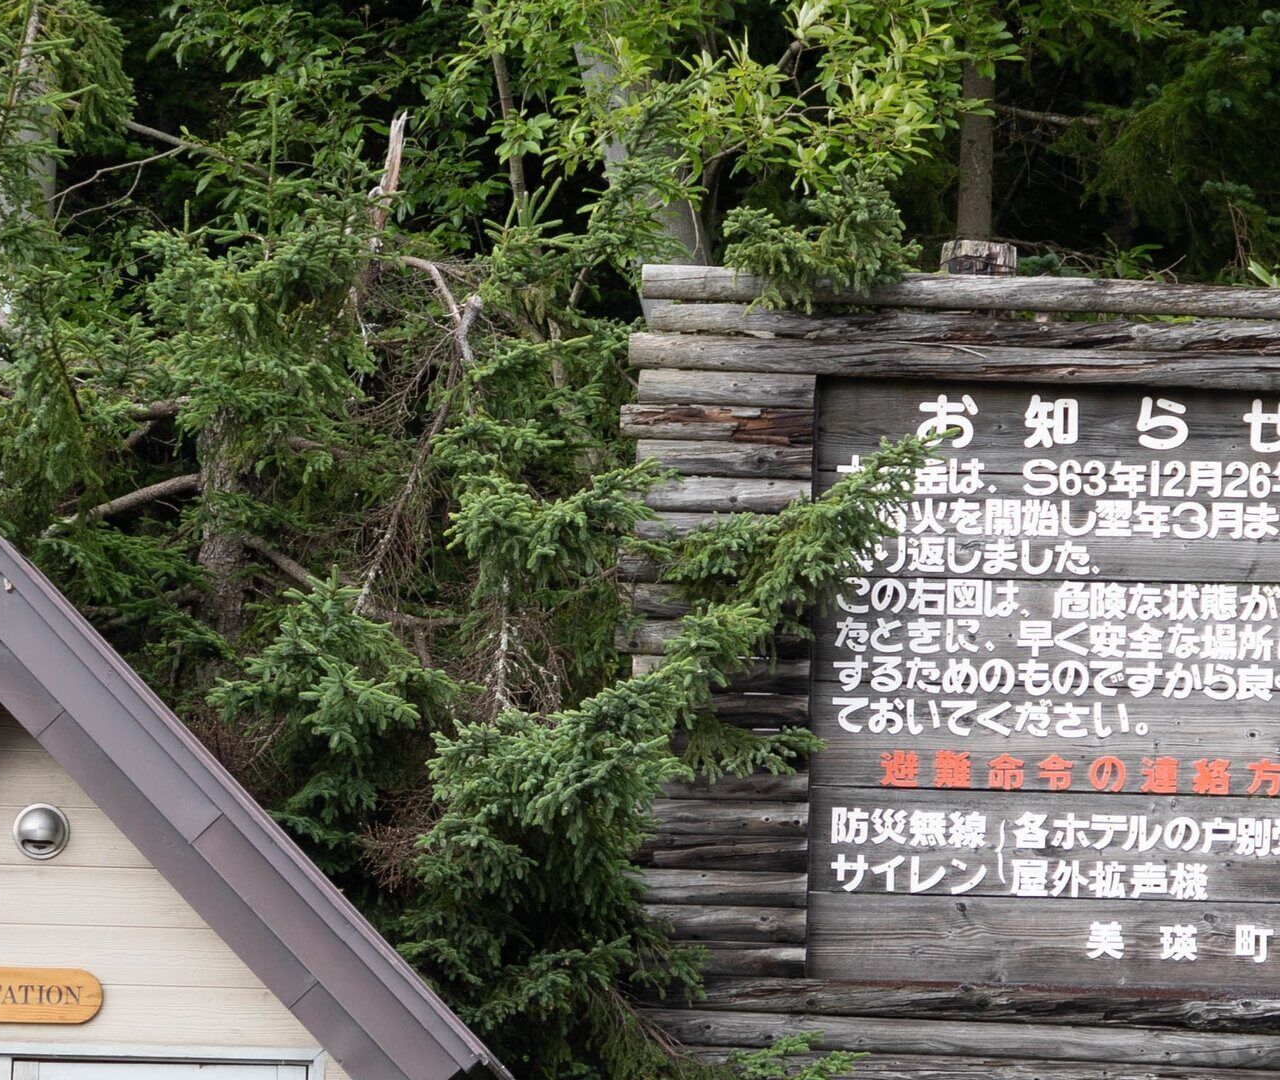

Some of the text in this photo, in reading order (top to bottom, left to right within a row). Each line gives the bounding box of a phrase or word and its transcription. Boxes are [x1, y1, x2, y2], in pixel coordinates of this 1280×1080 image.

[832, 697, 1148, 737] ておいてください。
[831, 806, 987, 848] 防災無線
[831, 854, 1208, 899] サイレン 屋外拡声機
